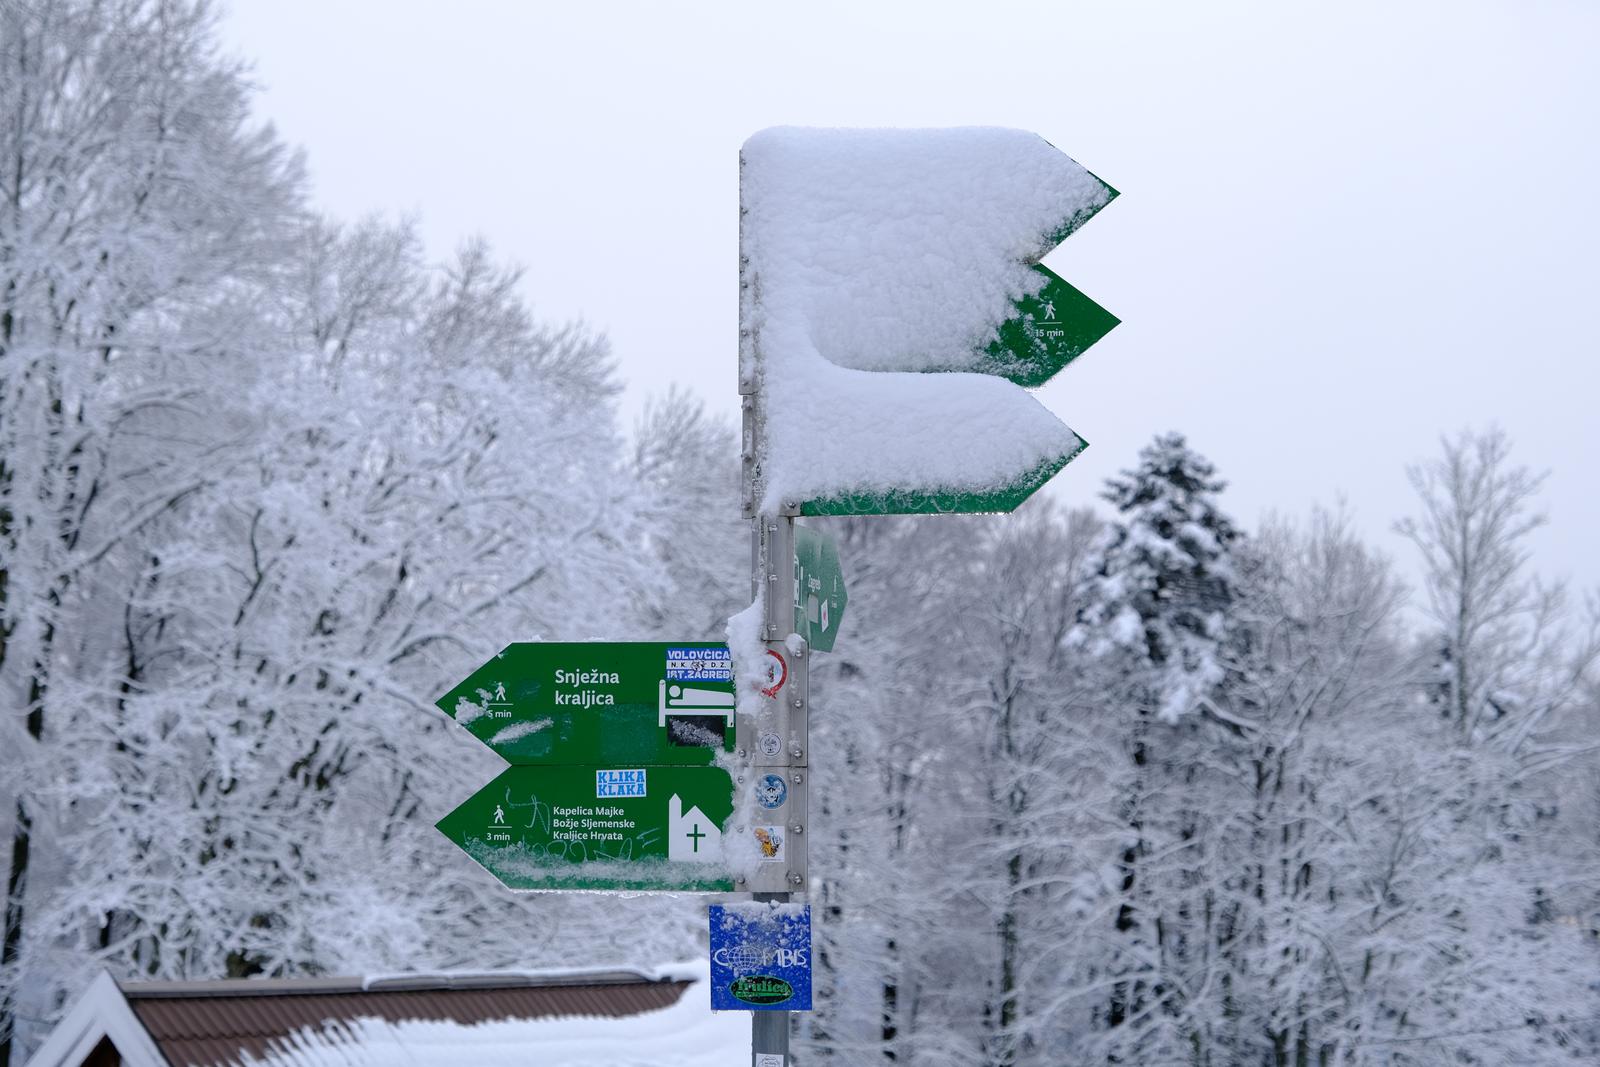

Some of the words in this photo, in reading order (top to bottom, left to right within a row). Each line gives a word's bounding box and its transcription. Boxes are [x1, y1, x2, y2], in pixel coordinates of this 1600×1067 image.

[1046, 328, 1064, 337] min
[667, 649, 730, 660] VOLOVČICA
[555, 668, 620, 688] Snježna
[555, 690, 615, 709] kraljica
[495, 709, 512, 718] min
[598, 771, 645, 783] KLIKA
[598, 784, 646, 796] KLAKA
[553, 806, 593, 816] Kapelica
[596, 806, 625, 816] Majke
[553, 818, 579, 829] Božje
[581, 818, 636, 829] Sljemenske
[487, 832, 492, 841] 3
[493, 832, 511, 841] min
[553, 831, 588, 841] Kraljice
[590, 831, 623, 840] Hrvata
